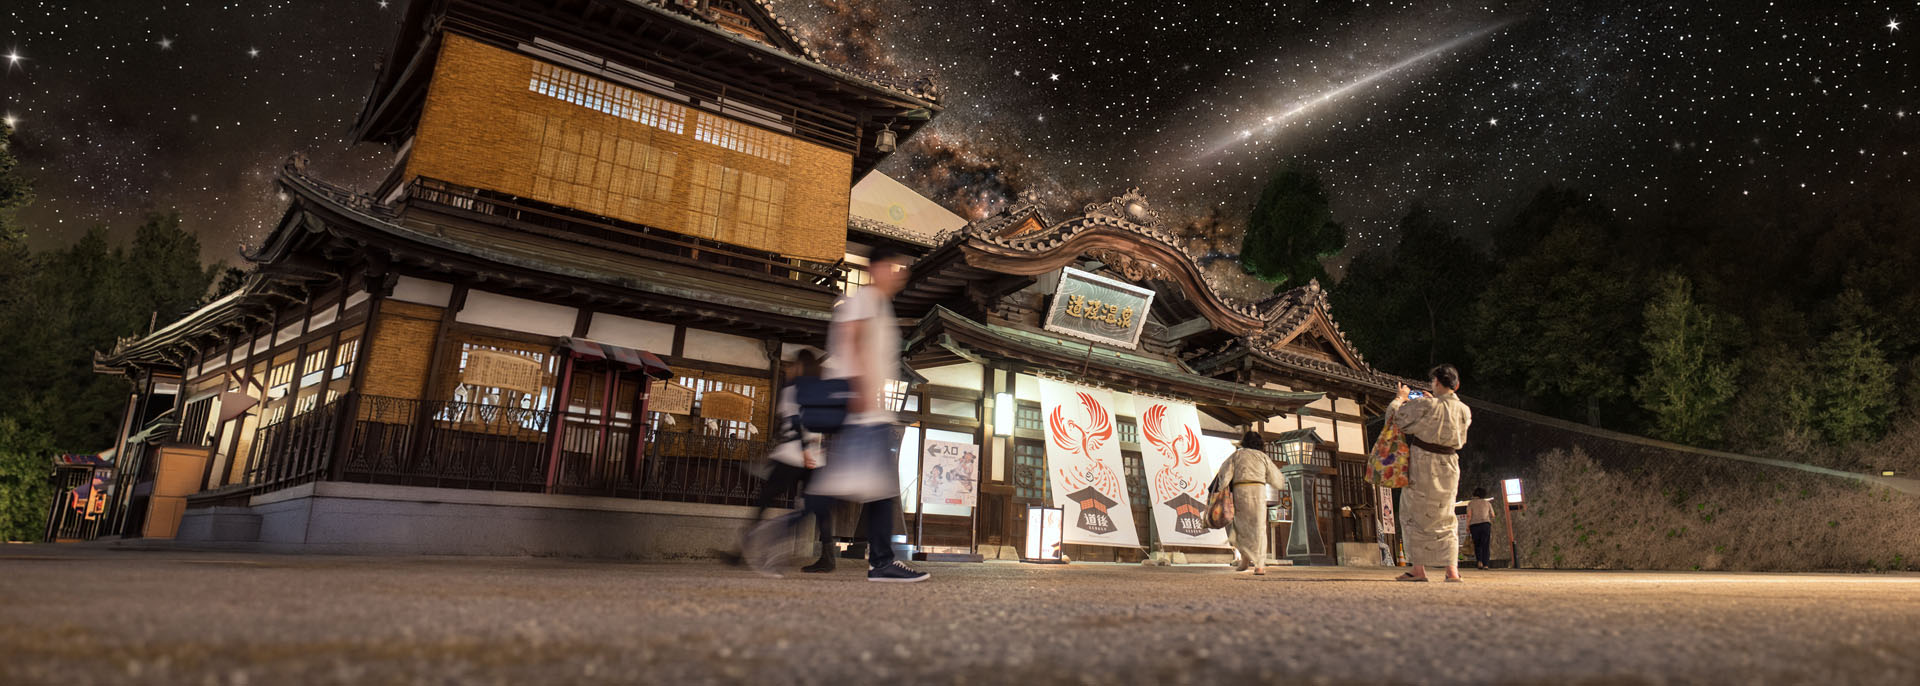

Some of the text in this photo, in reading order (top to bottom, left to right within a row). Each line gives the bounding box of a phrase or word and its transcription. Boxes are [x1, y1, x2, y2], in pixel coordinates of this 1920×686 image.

[1066, 295, 1133, 328] 道後温泉
[943, 445, 958, 455] 入口
[1084, 513, 1108, 527] 道後
[1180, 518, 1202, 530] 道後
